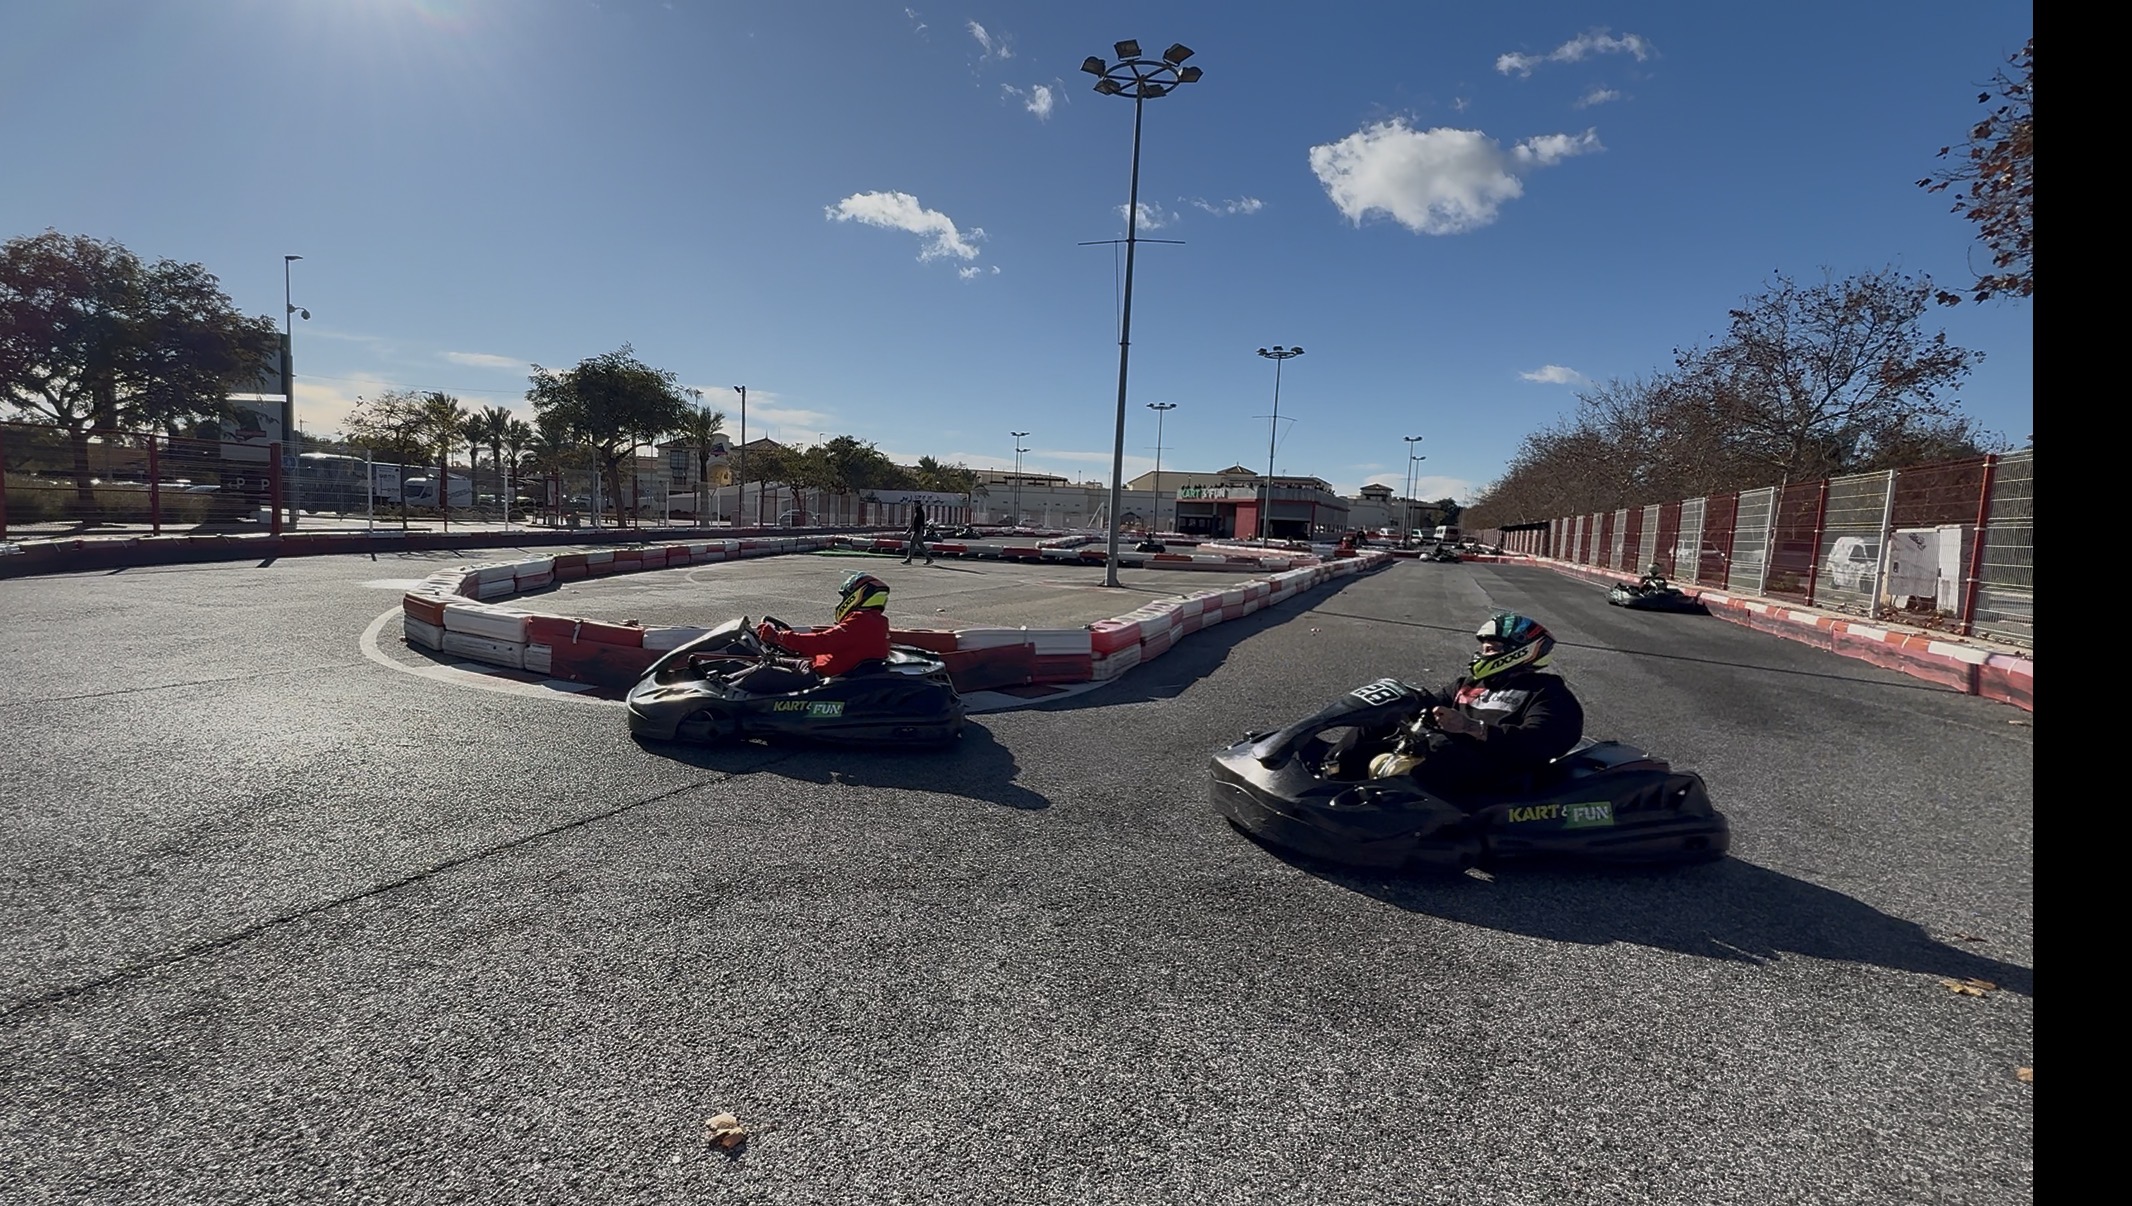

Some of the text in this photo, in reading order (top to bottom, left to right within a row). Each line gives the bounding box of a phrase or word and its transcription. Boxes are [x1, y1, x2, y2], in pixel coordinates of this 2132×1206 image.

[1180, 488, 1201, 499] KART
[1209, 488, 1228, 499] FUN
[773, 701, 808, 711] KART
[812, 704, 841, 714] FUN
[1508, 804, 1560, 822] KART
[1573, 806, 1609, 822] FUN
